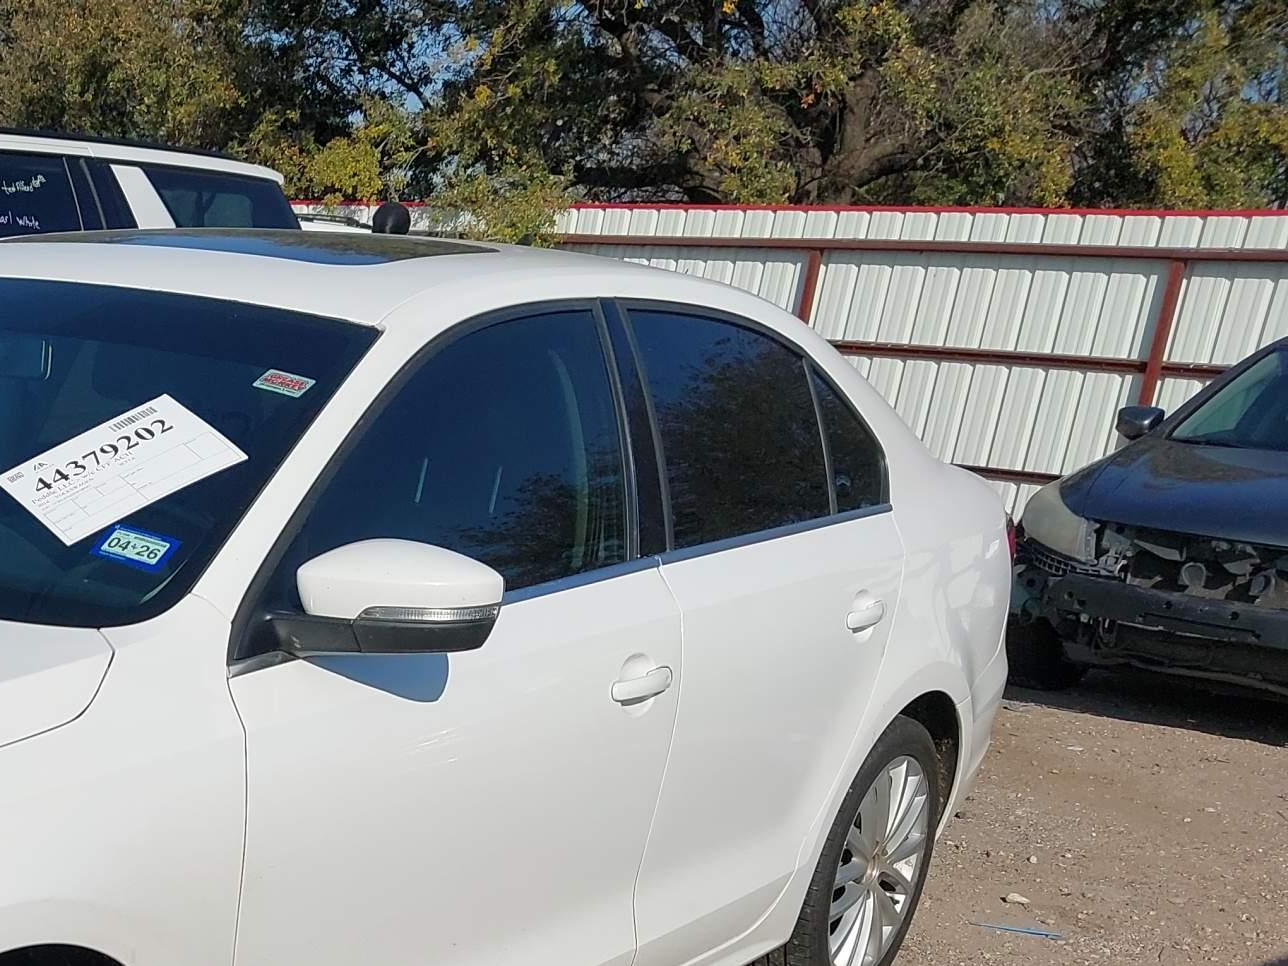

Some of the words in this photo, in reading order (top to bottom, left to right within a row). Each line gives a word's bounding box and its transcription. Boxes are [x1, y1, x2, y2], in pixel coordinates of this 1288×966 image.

[35, 419, 174, 492] 44379202
[107, 537, 131, 552] 04
[134, 545, 161, 560] 26
